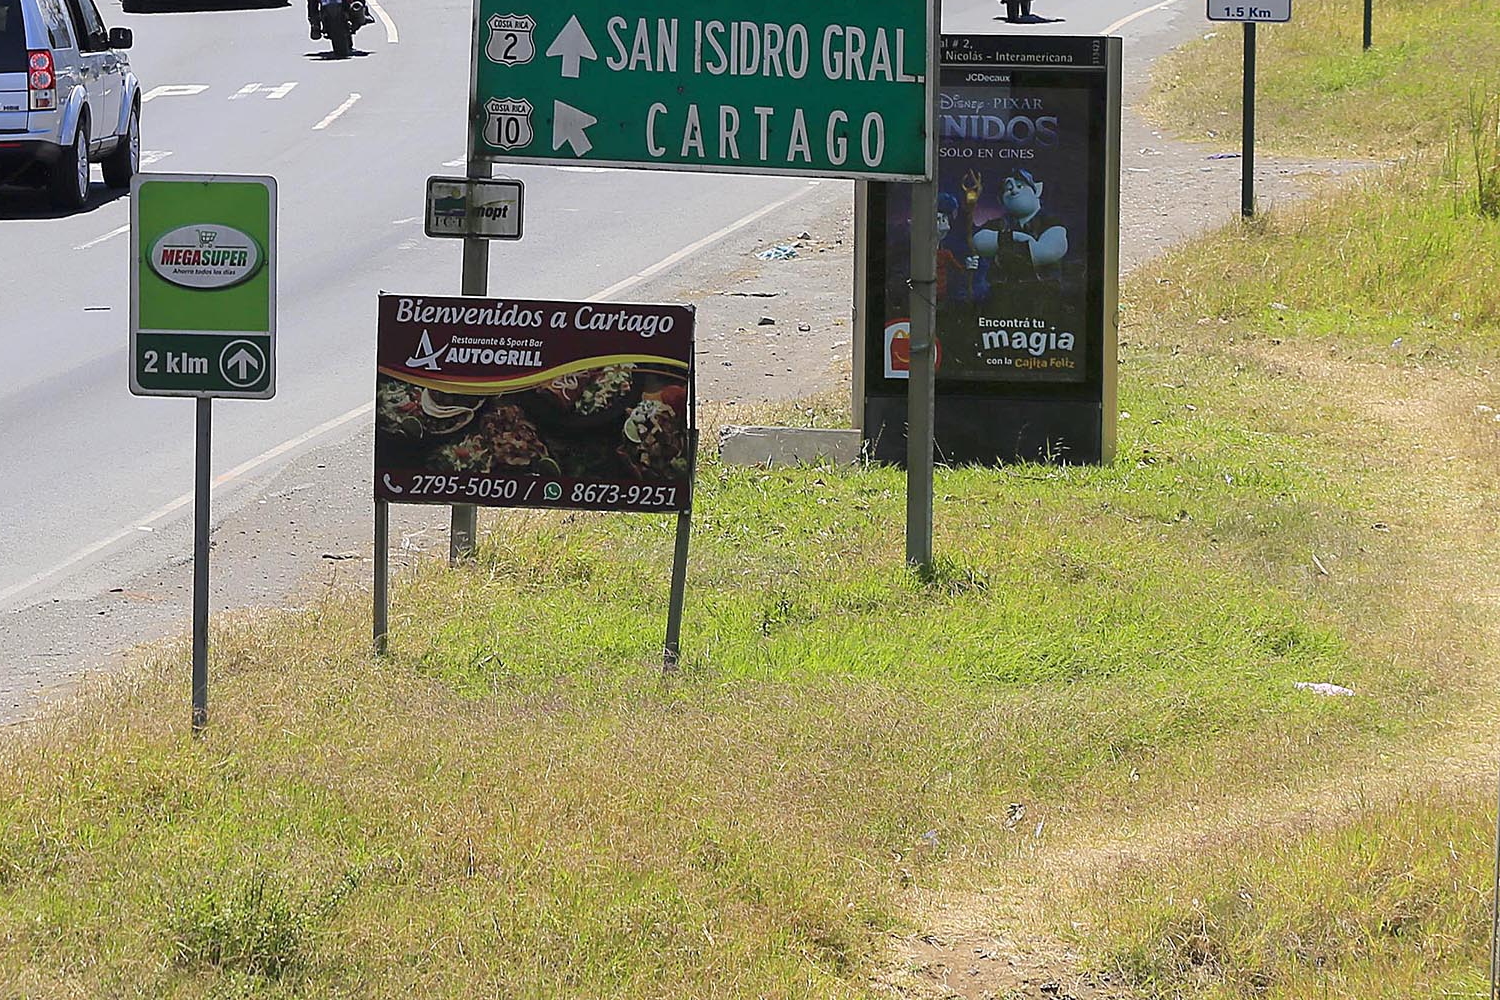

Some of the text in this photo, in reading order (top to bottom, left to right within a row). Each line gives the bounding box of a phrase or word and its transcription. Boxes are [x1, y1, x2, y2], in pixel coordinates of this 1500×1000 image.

[1224, 6, 1271, 18] 1.5 Km
[493, 19, 529, 30] COSTA RICA
[503, 32, 518, 61] 2
[606, 15, 925, 84] SAN ISIDRO GRAL.
[946, 51, 983, 61] Nicolás
[995, 52, 1073, 63] Interamericana
[966, 73, 1011, 83] JCDecaux
[490, 103, 527, 114] COSTA RICA
[993, 97, 1044, 111] PIXAR
[495, 116, 520, 145] 10
[645, 102, 886, 168] CARTAGO
[940, 114, 1059, 147] NIDOS
[940, 147, 1035, 160] SOLO EN CINES
[161, 249, 248, 267] MEGASUPER
[396, 298, 675, 338] Bienvenidos a Cartago
[978, 317, 1045, 329] Encontrá tu
[451, 335, 544, 348] Restaurante & Sport Bar
[982, 326, 1075, 357] magia
[144, 350, 159, 374] 2
[445, 347, 543, 367] AUTOGRILL
[1004, 357, 1012, 365] la
[1014, 358, 1048, 370] Cajita
[1049, 358, 1075, 369] Feliz
[409, 474, 518, 500] 2795-5050
[571, 482, 677, 506] 8673-9251
